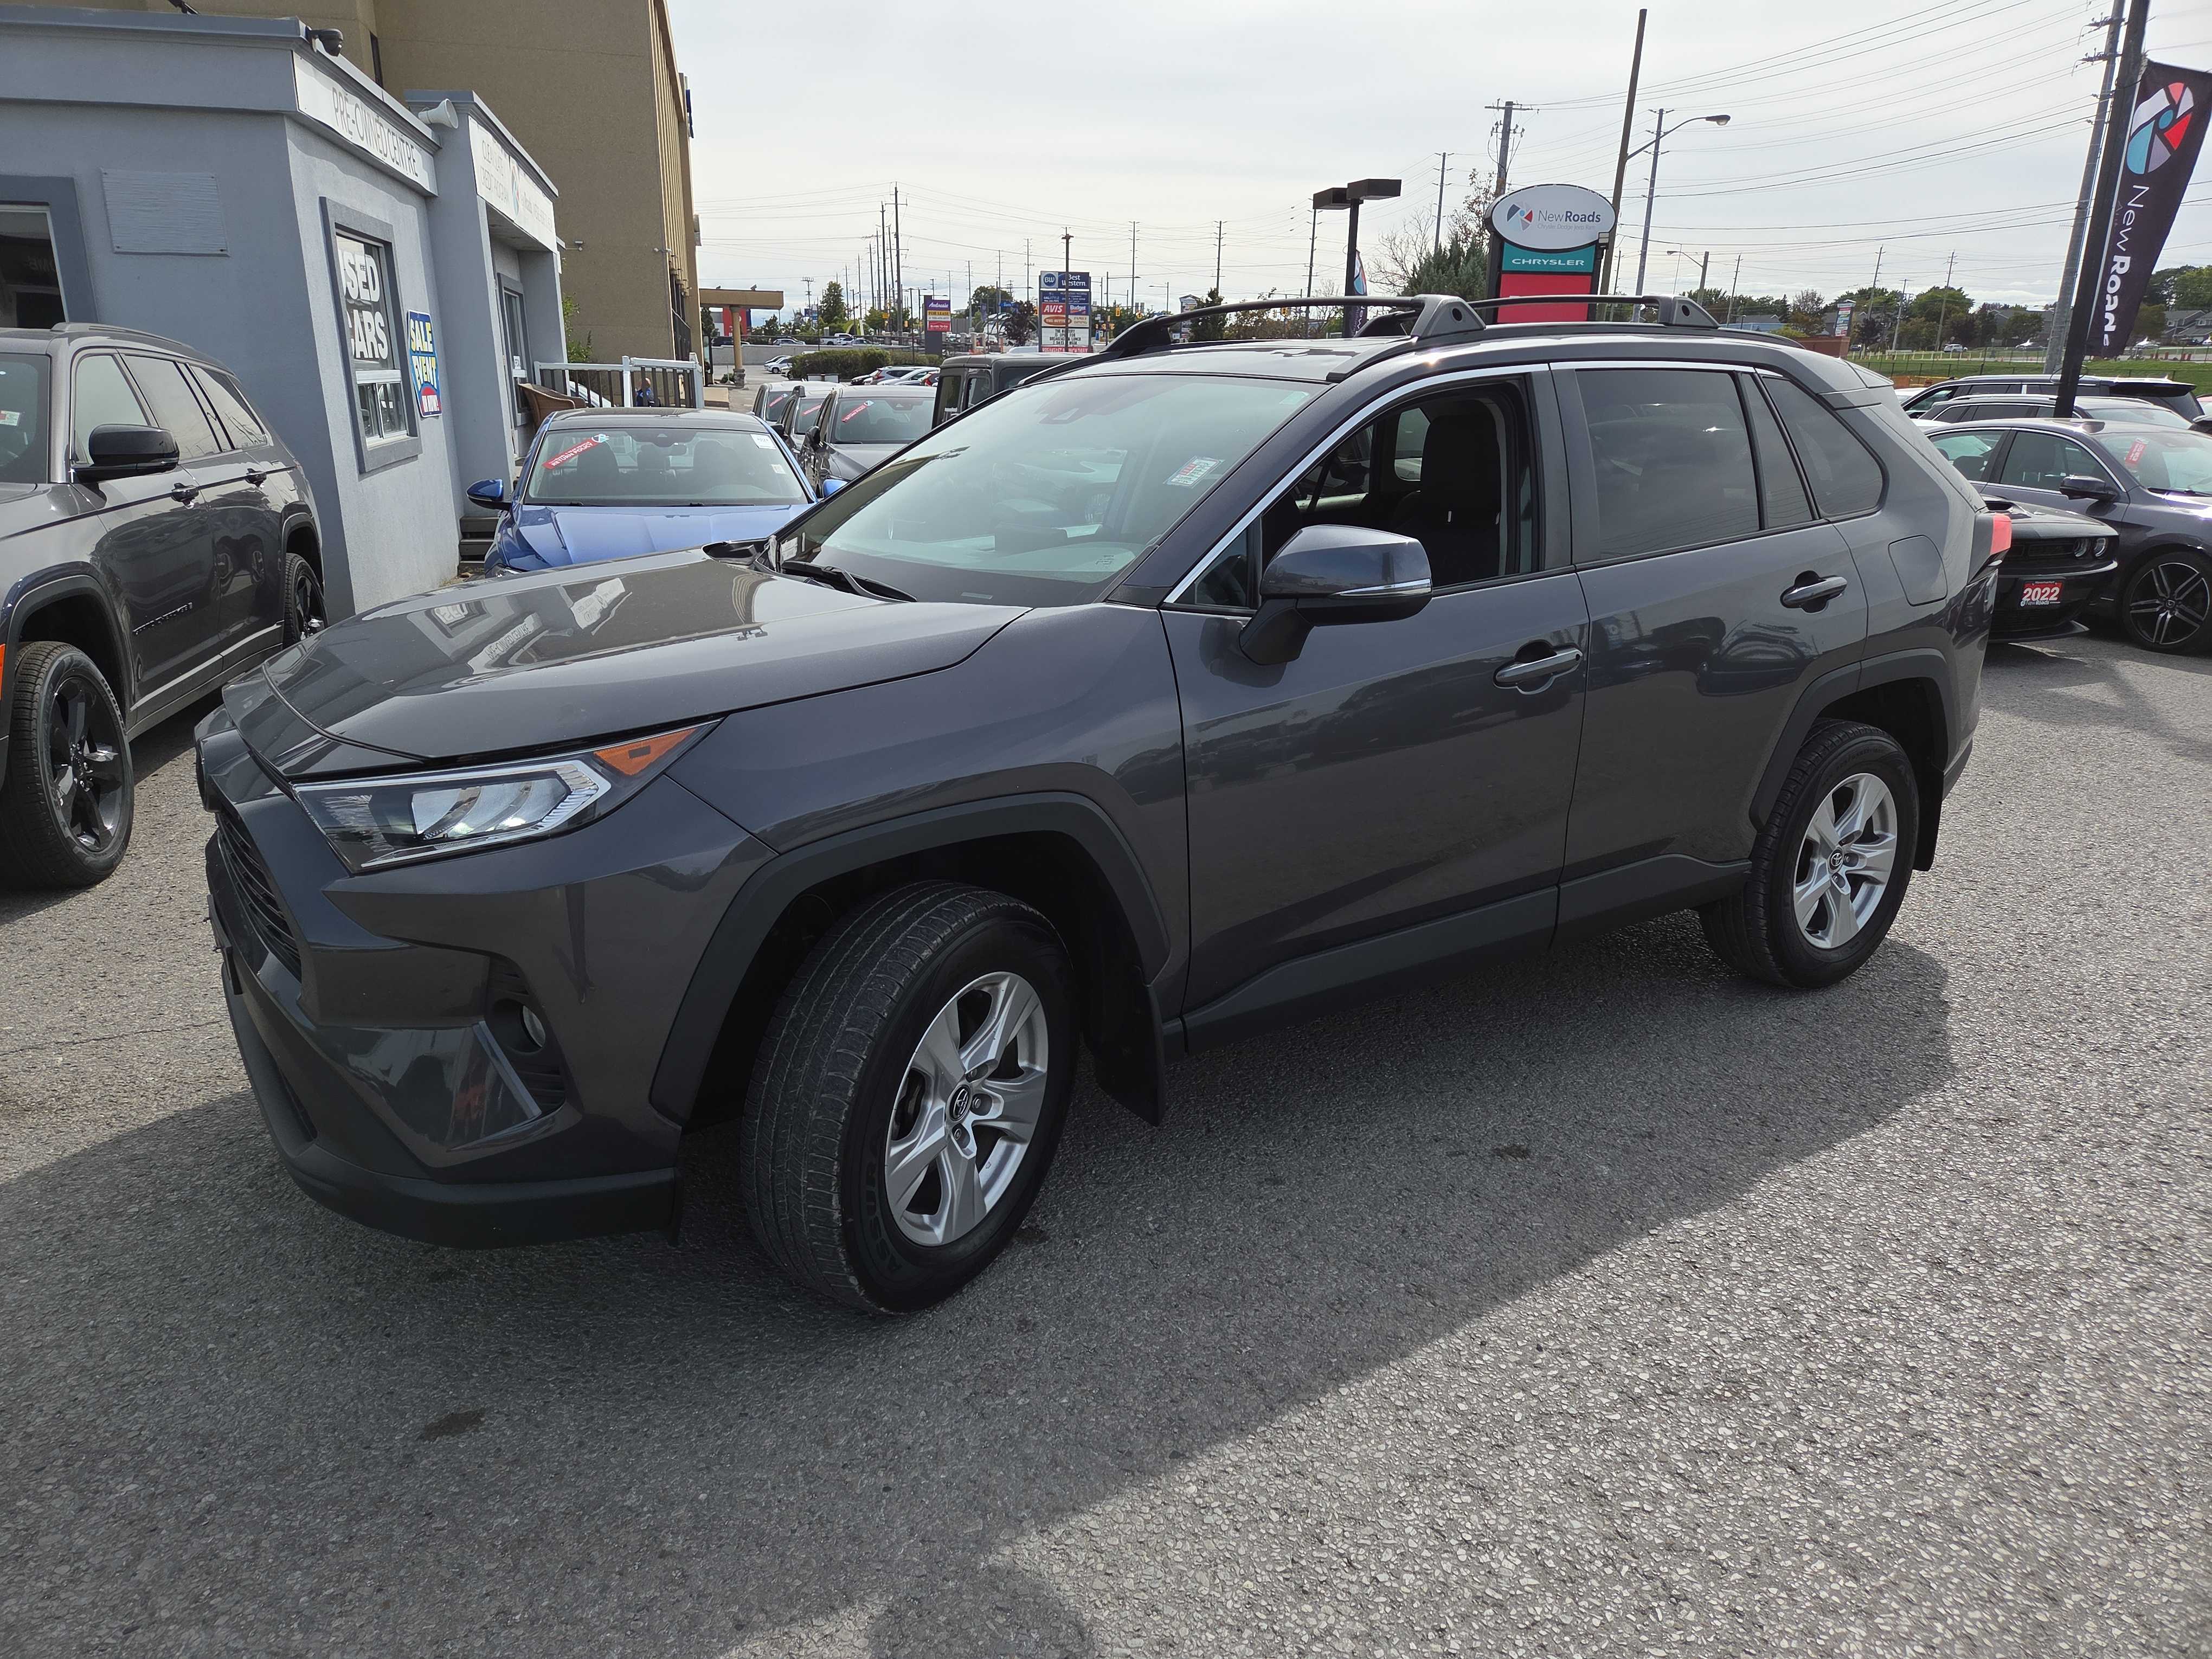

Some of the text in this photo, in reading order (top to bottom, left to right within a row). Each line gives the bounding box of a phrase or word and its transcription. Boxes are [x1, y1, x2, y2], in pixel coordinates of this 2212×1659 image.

[332, 87, 388, 158] PRE-OWNED
[387, 128, 418, 177] CENTRE
[1538, 210, 1601, 222] NewRoads
[1044, 305, 1063, 313] AVIS
[410, 318, 434, 352] SALE
[412, 355, 437, 391] EVENT
[551, 453, 575, 466] RETURN
[573, 442, 593, 454] POLICY
[2022, 587, 2060, 601] 2022
